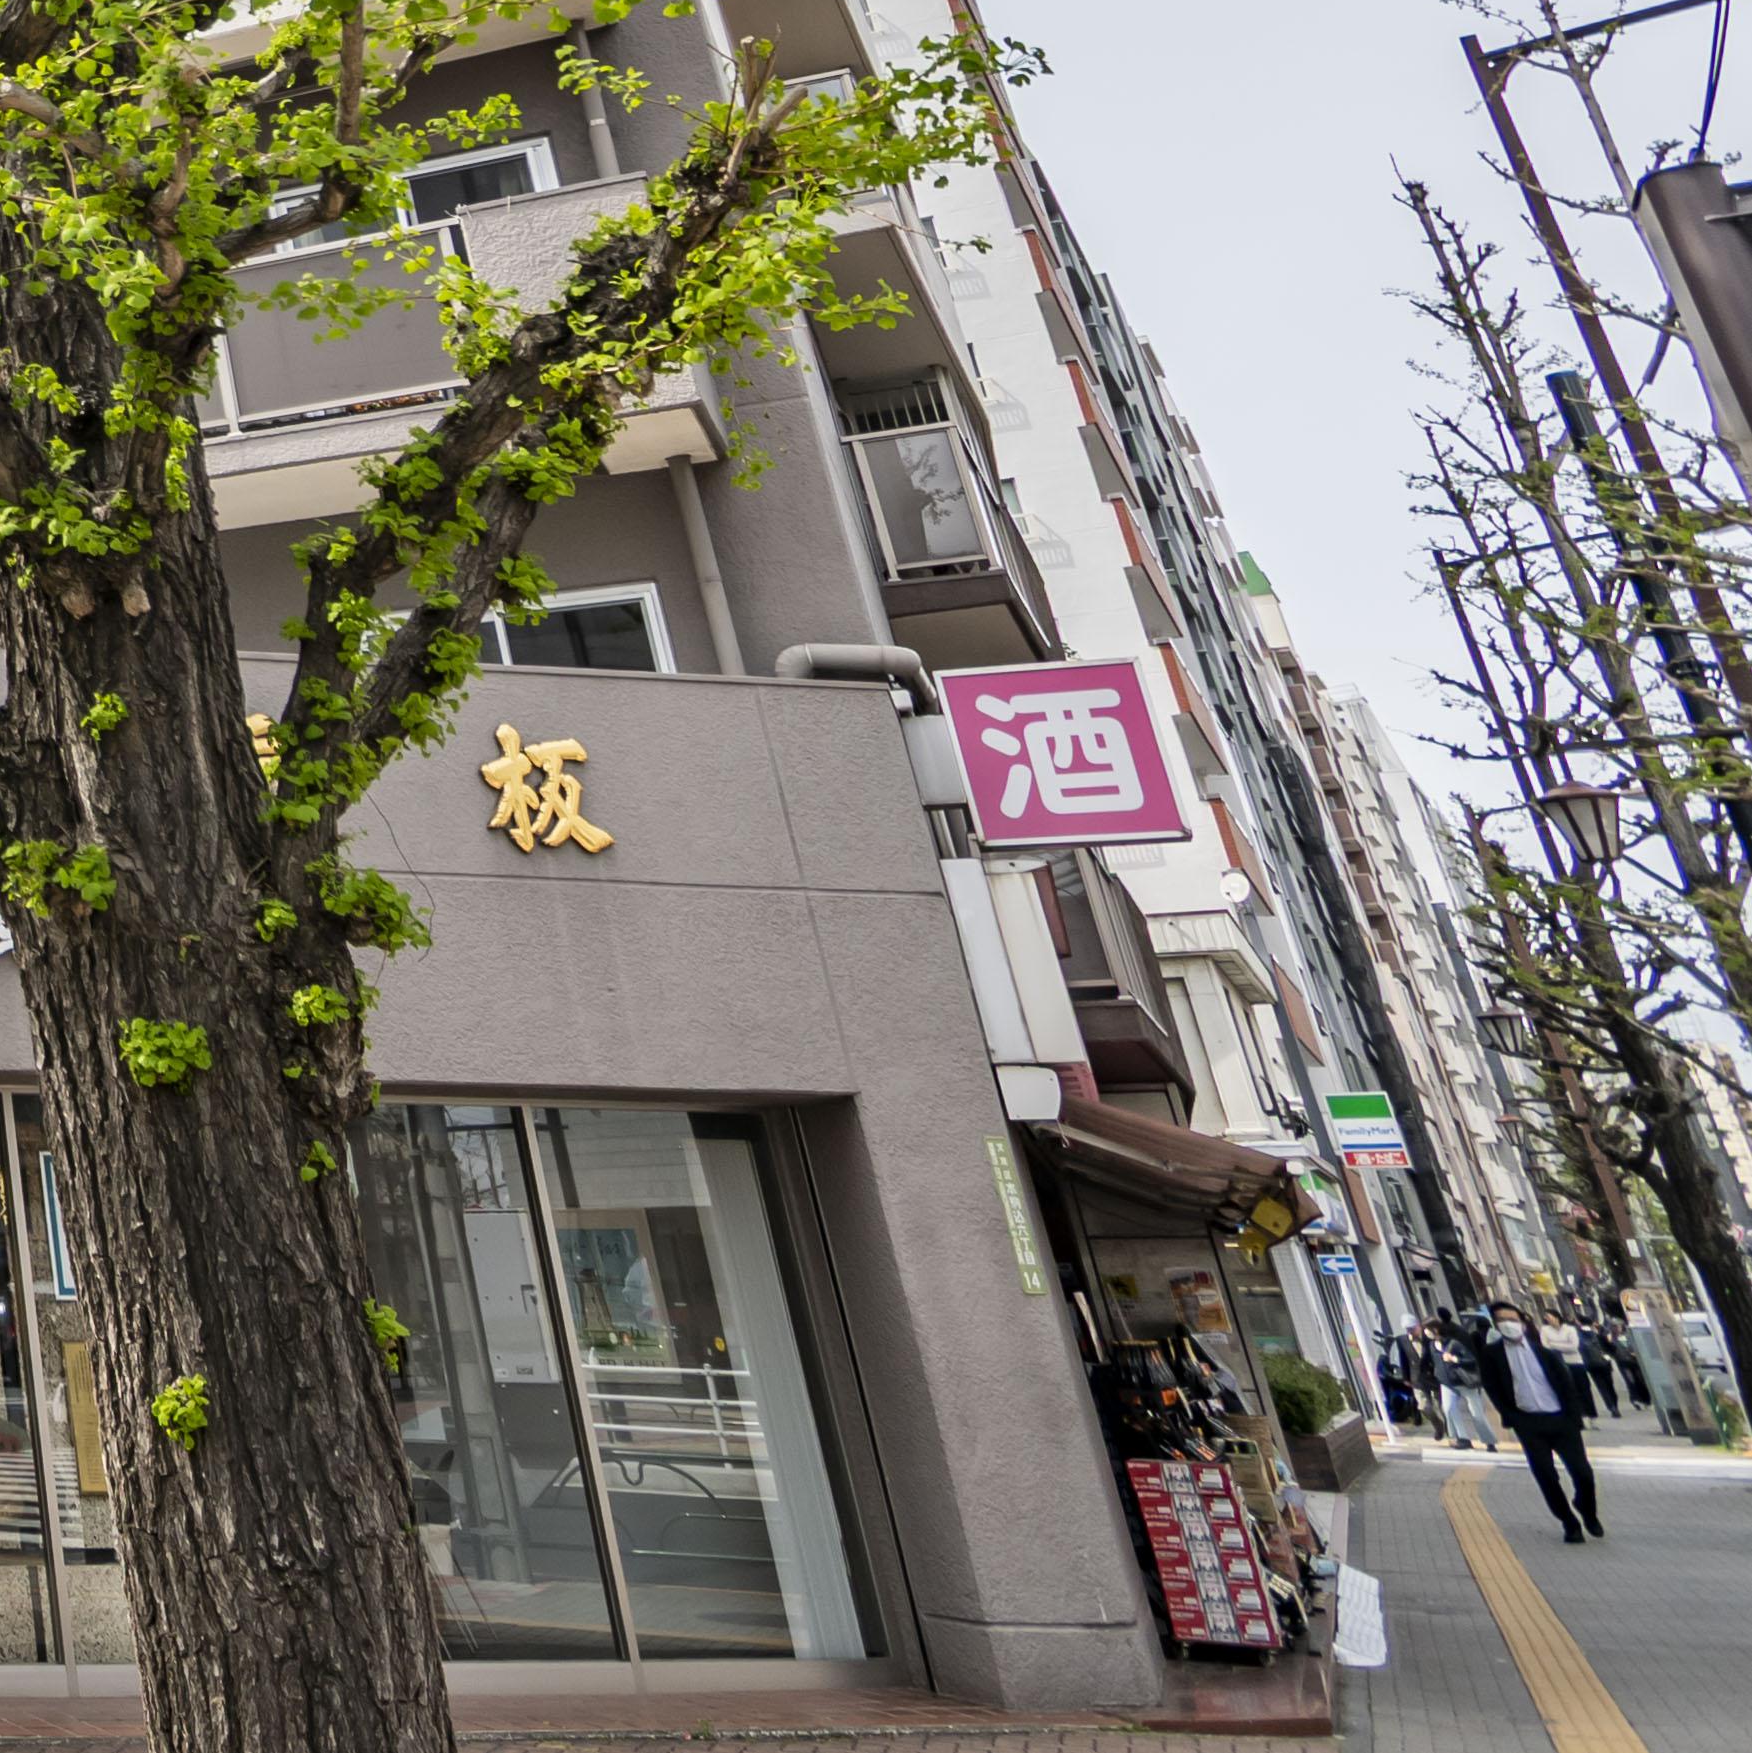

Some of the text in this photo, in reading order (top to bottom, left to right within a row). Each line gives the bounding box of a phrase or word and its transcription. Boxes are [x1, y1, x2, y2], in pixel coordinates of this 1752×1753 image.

[975, 688, 1144, 818] 酒
[1338, 1127, 1396, 1136] FamilyMart
[1024, 1272, 1041, 1289] 14
